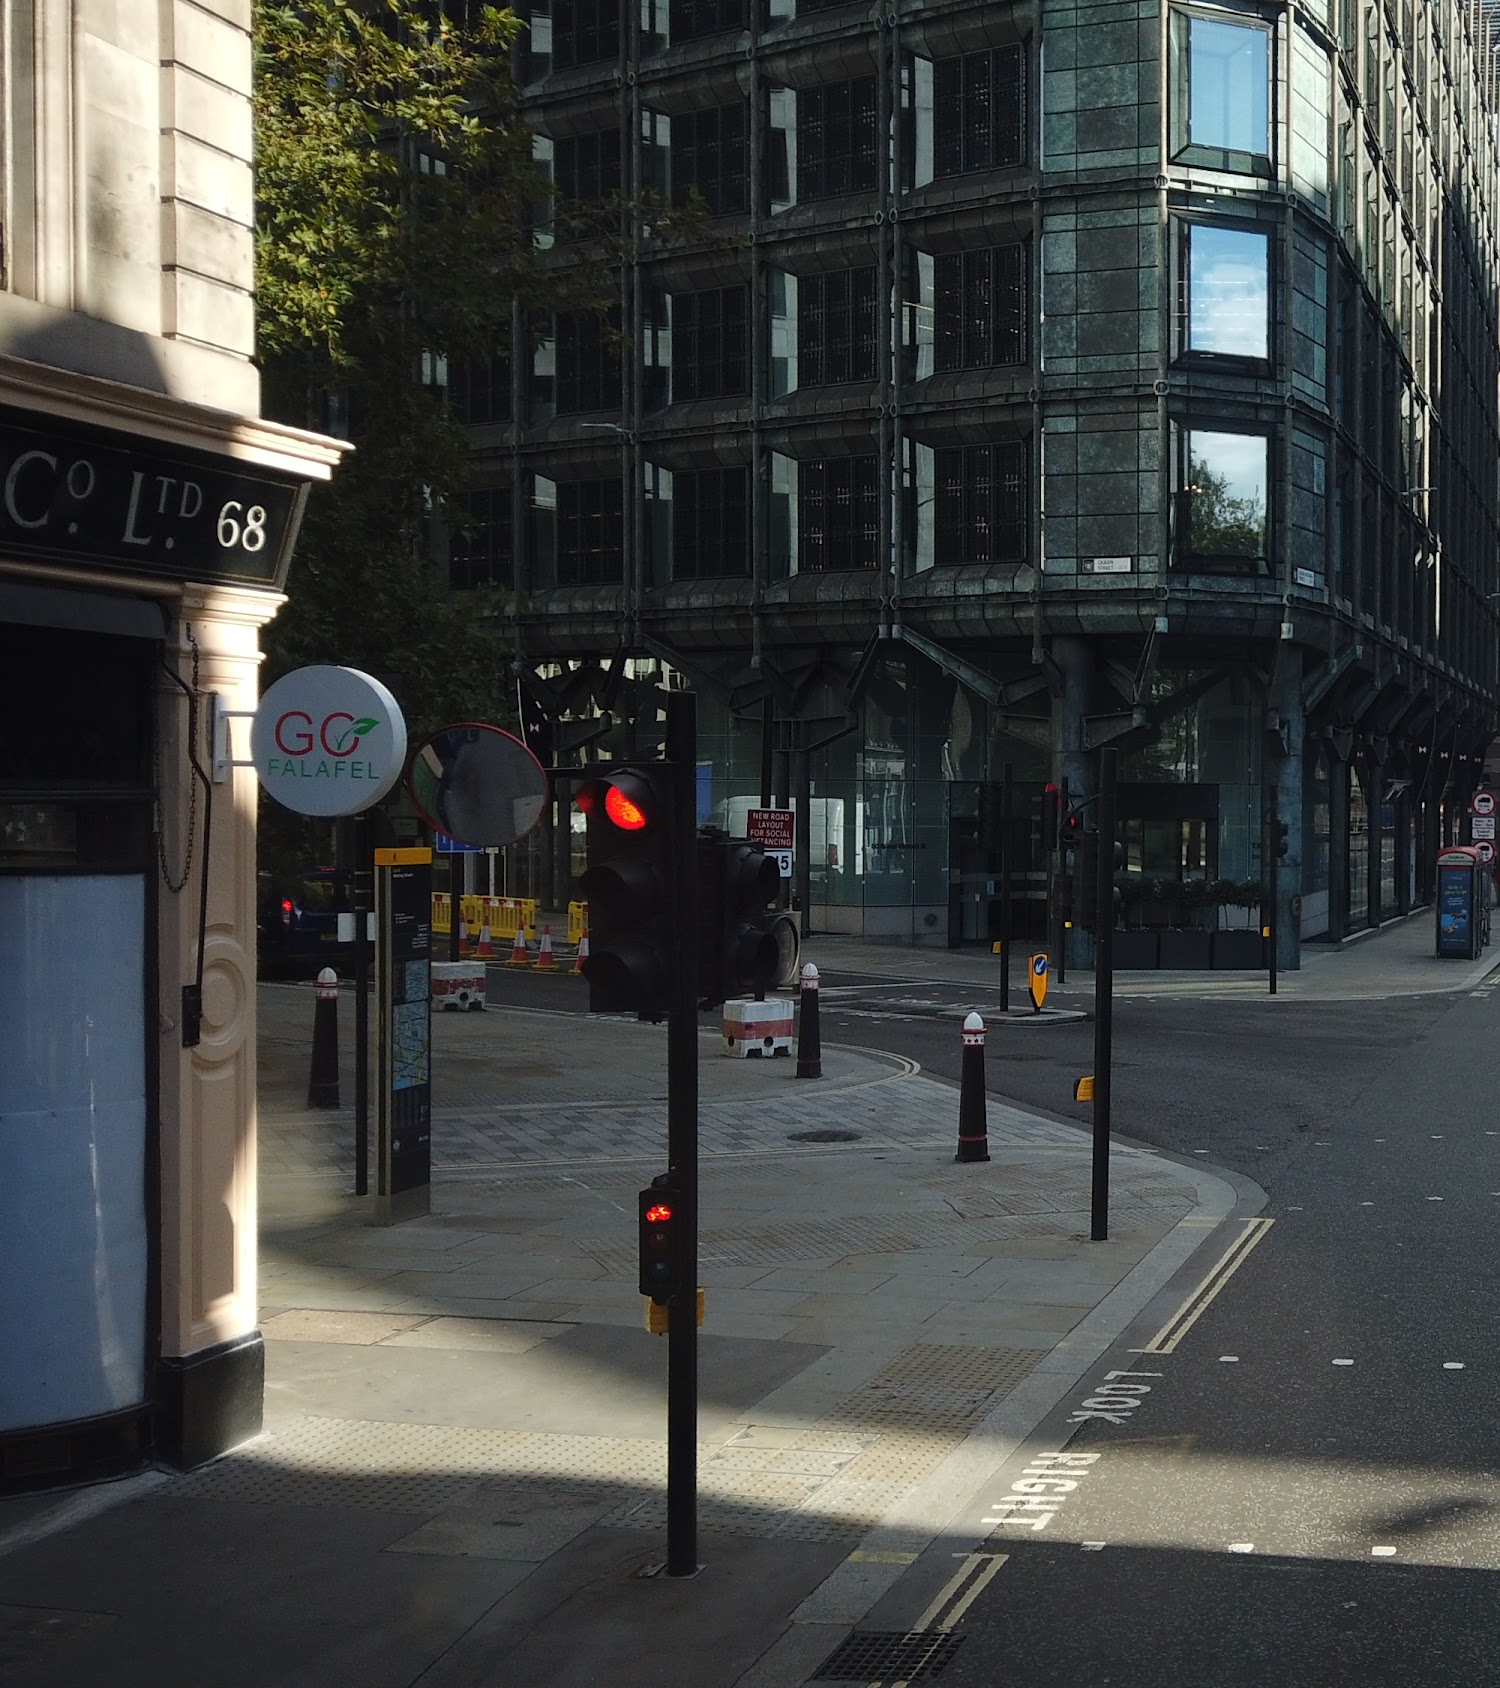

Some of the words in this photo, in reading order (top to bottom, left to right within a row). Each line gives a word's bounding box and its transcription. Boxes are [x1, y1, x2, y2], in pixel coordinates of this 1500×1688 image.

[216, 499, 268, 553] 68
[274, 710, 361, 758] GO
[267, 757, 381, 781] FALAFEL
[750, 829, 765, 837] FOR
[765, 829, 791, 838] SOCIAL
[752, 812, 769, 820] NEW
[770, 813, 790, 821] ROAD
[757, 821, 784, 829] LAYOUT
[1065, 1370, 1164, 1425] LOOK
[980, 1451, 1102, 1531] RIGHT
